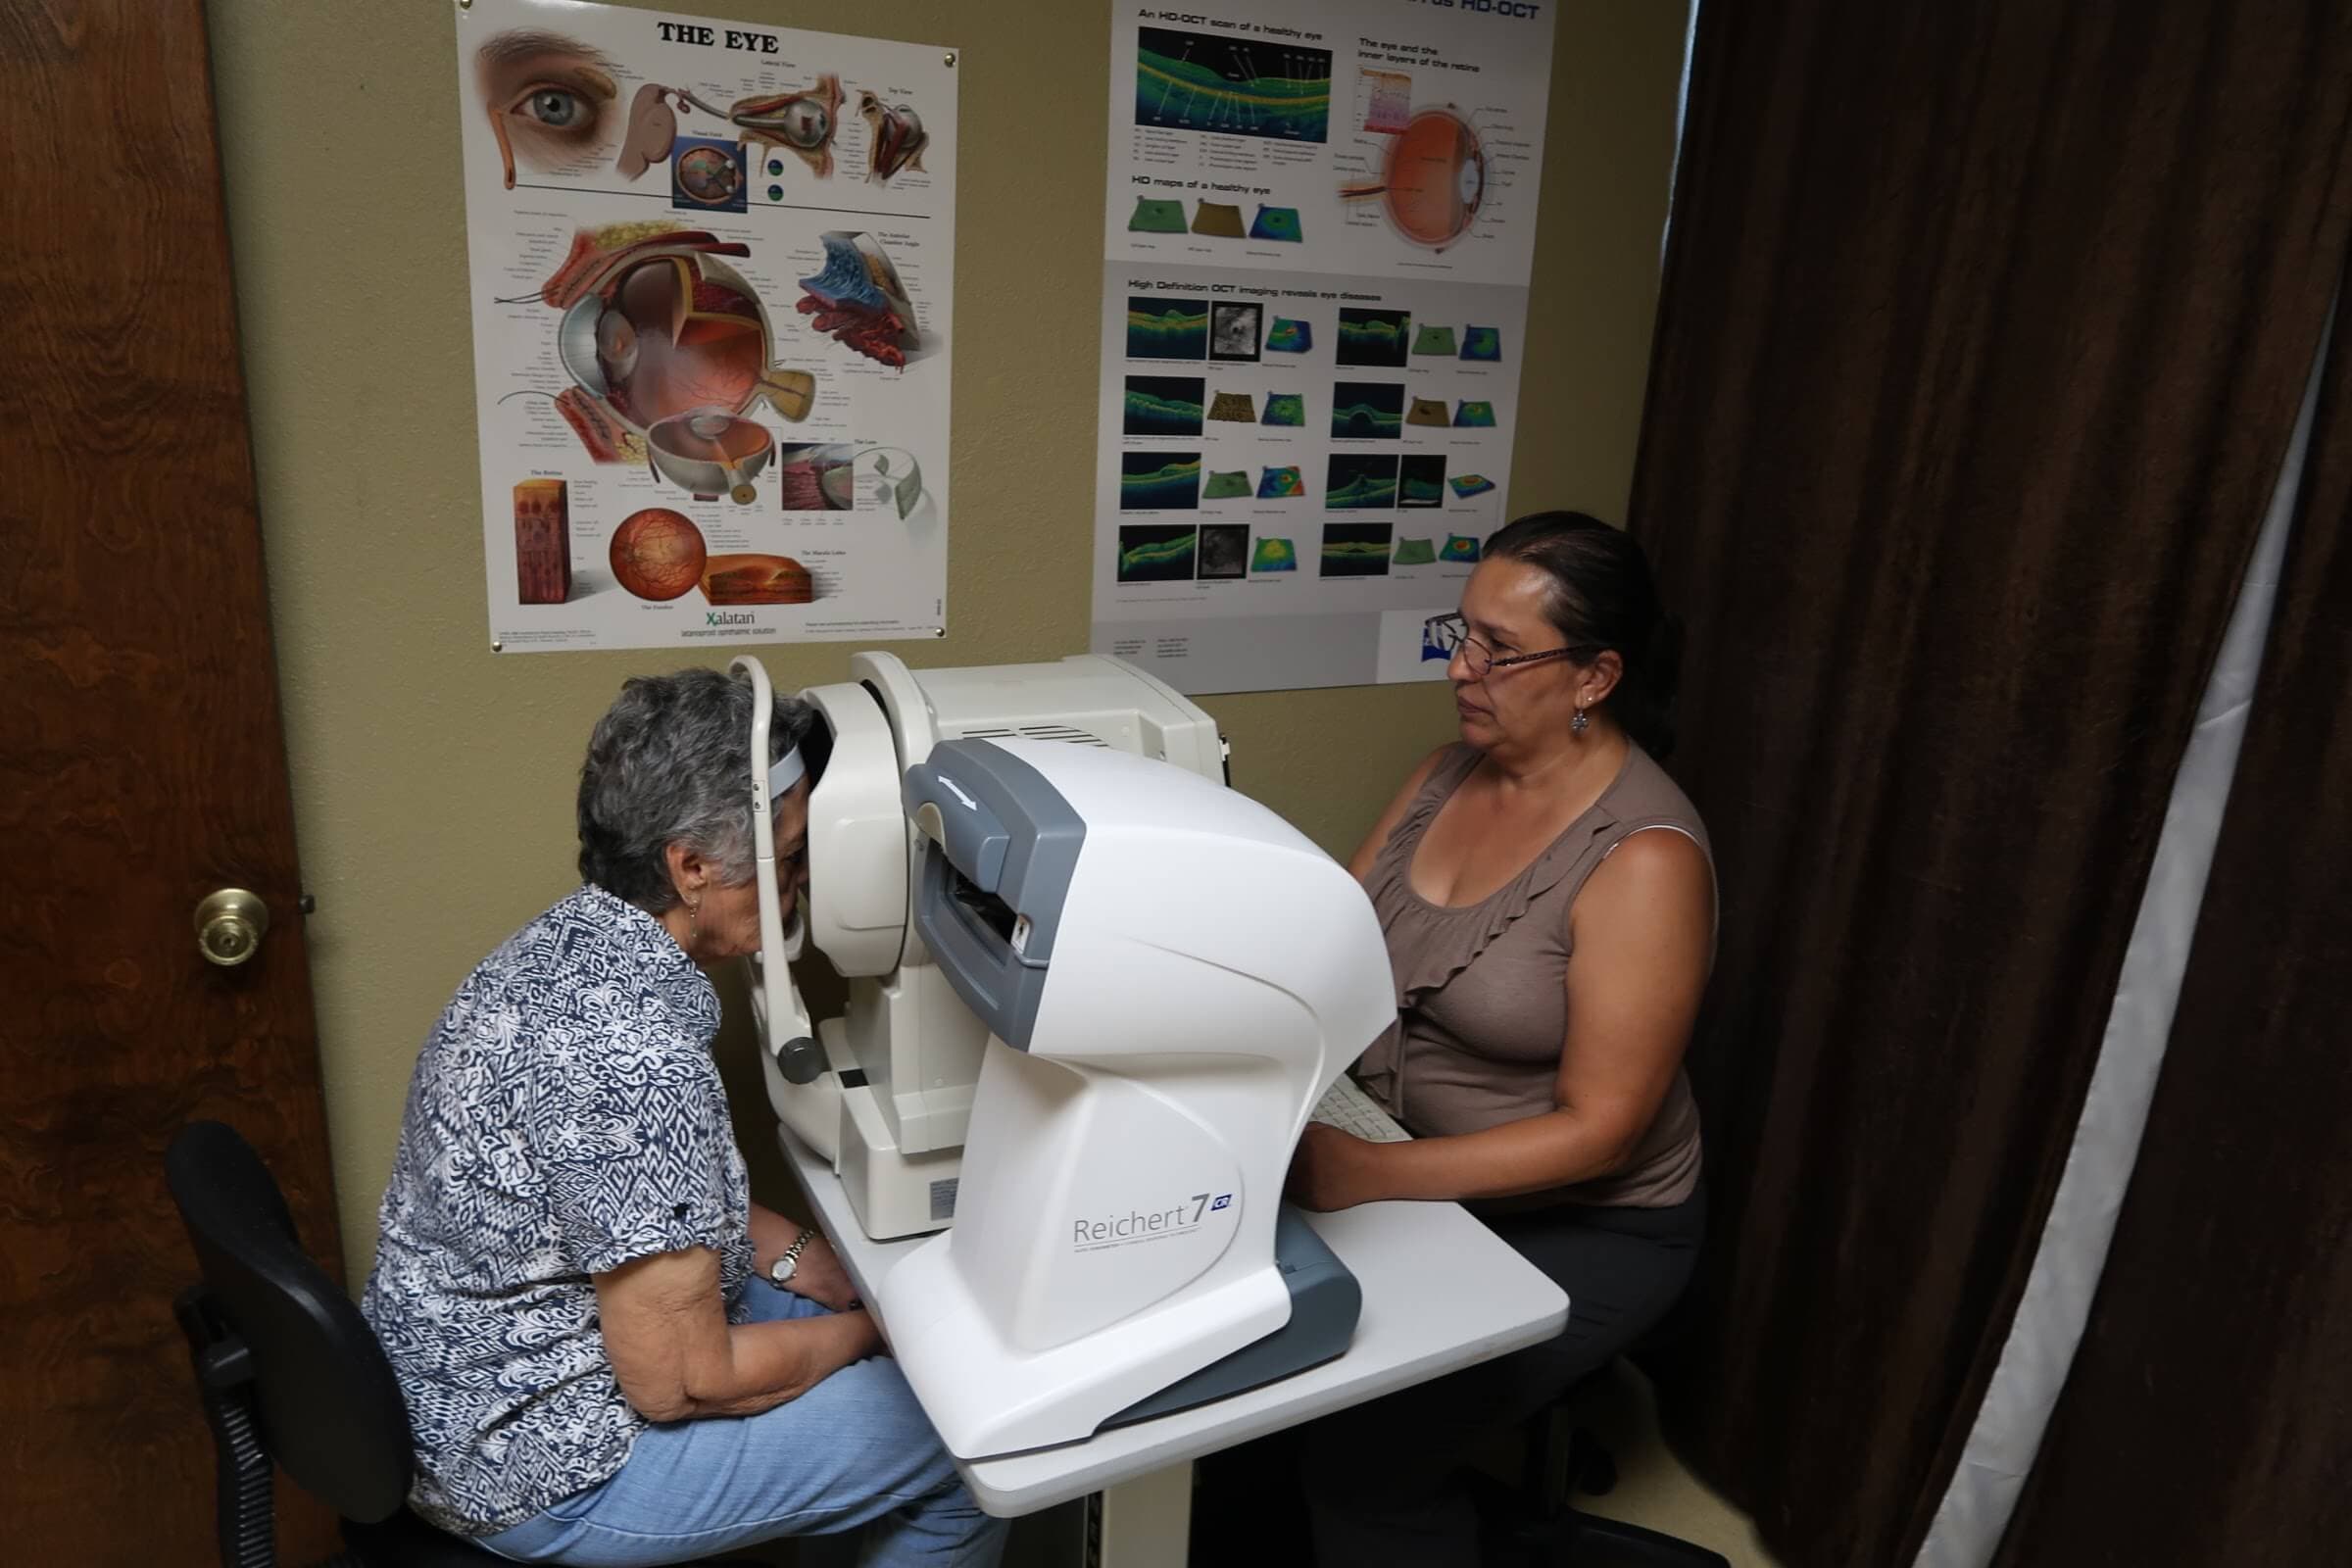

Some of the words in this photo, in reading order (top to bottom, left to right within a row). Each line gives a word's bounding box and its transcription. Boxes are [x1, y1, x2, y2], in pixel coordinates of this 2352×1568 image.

[1139, 9, 1154, 20] An
[1159, 11, 1207, 25] HD-OCT
[1210, 19, 1237, 29] scan
[1239, 22, 1250, 31] of
[1263, 24, 1301, 39] healthy
[1304, 31, 1323, 41] eye
[657, 22, 714, 46] THE
[725, 29, 779, 54] EYE
[1359, 37, 1378, 48] The
[1380, 41, 1397, 51] eye
[1400, 43, 1419, 53] and
[1421, 45, 1439, 56] the
[1357, 49, 1384, 60] inner
[1387, 52, 1416, 66] layers
[1419, 56, 1430, 66] of
[1432, 59, 1448, 69] the
[1132, 175, 1151, 185] HD
[1153, 178, 1184, 189] maps
[1187, 179, 1199, 189] of
[1211, 182, 1250, 196] healthy
[1253, 186, 1271, 196] eye
[1128, 279, 1152, 291] High
[1156, 281, 1208, 293] Definition
[1211, 283, 1237, 293] OCT
[1239, 285, 1279, 298] imaging
[706, 611, 756, 627] Xalatan
[1074, 1205, 1185, 1244] Reichert
[1191, 1193, 1210, 1223] 7
